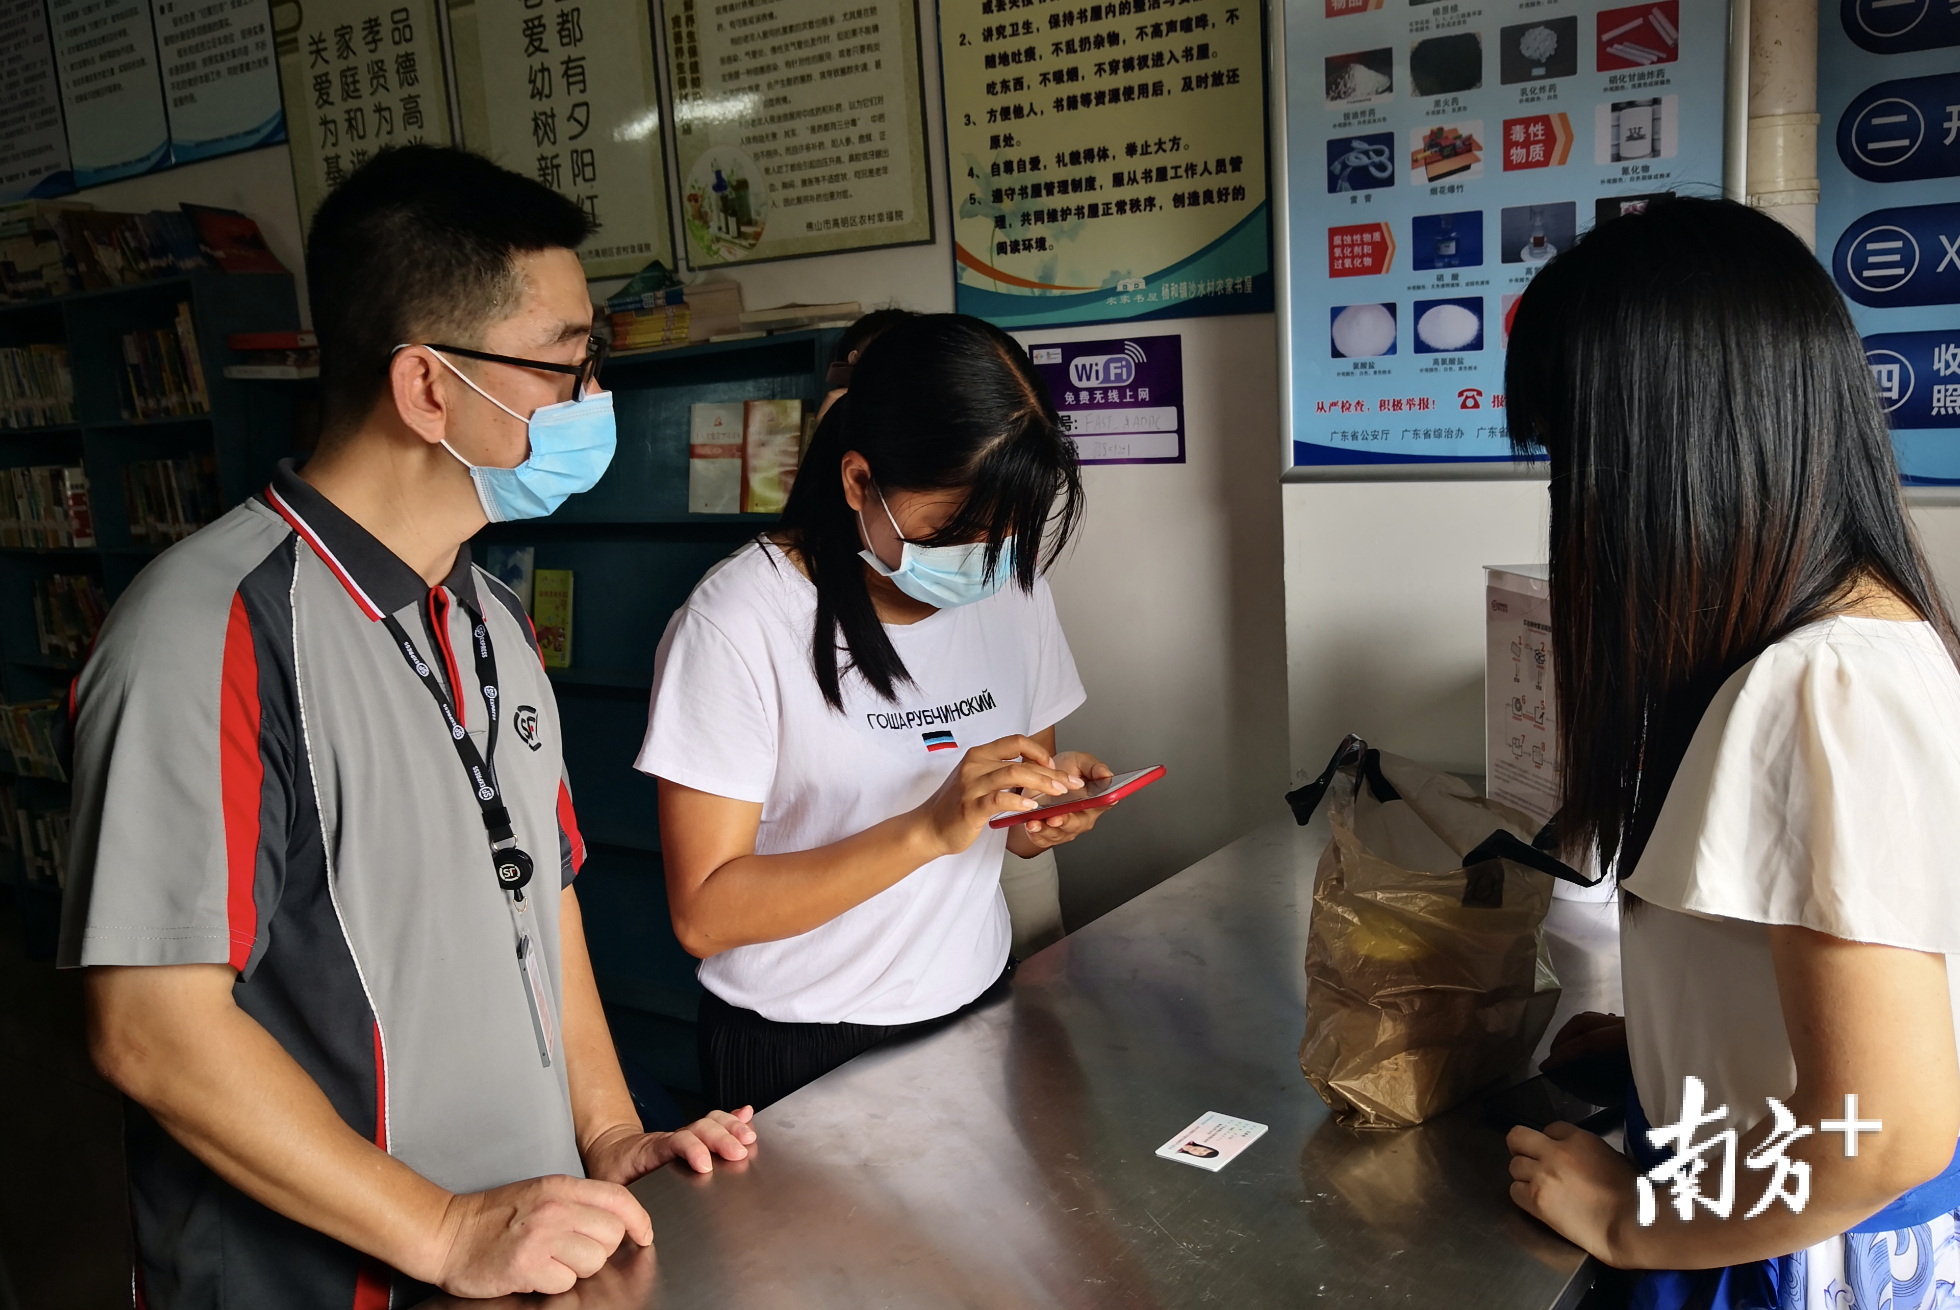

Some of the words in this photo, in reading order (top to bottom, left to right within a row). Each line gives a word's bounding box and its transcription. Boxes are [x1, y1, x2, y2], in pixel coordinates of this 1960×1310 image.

[362, 15, 394, 149] 孝贤为
[1609, 69, 1665, 84] 硝化甘油炸药
[1520, 84, 1557, 97] 乳化炸药
[1433, 97, 1459, 108] 黑火药
[308, 31, 343, 190] 关爱为基
[555, 0, 602, 228] 都有夕阳红
[1509, 122, 1546, 143] 毒性
[990, 134, 1021, 150] 原处。
[1509, 144, 1545, 164] 物质
[1621, 165, 1650, 176] 氰化物
[1429, 185, 1464, 196] 烟花爆竹
[994, 185, 1245, 230] 理，共同维护书屋正常秩序，创造良好的
[806, 210, 904, 231] 佛山市高明区农村幸福院
[997, 236, 1053, 255] 阅读环境。
[1333, 231, 1382, 246] 腐蚀性物质
[1333, 244, 1373, 258] 氧化剂和
[1333, 257, 1373, 270] 过氧化物
[1352, 361, 1375, 370] 氯酸盐
[1432, 357, 1464, 366] 高氯酸盐
[1064, 387, 1150, 405] 免费无线上网
[1330, 430, 1390, 442] 广东省公安厅
[1401, 428, 1465, 441] 广东省综治办
[866, 688, 997, 730] ГОШАРУБЧИНСКИЙ
[472, 765, 486, 789] EXPRESS
